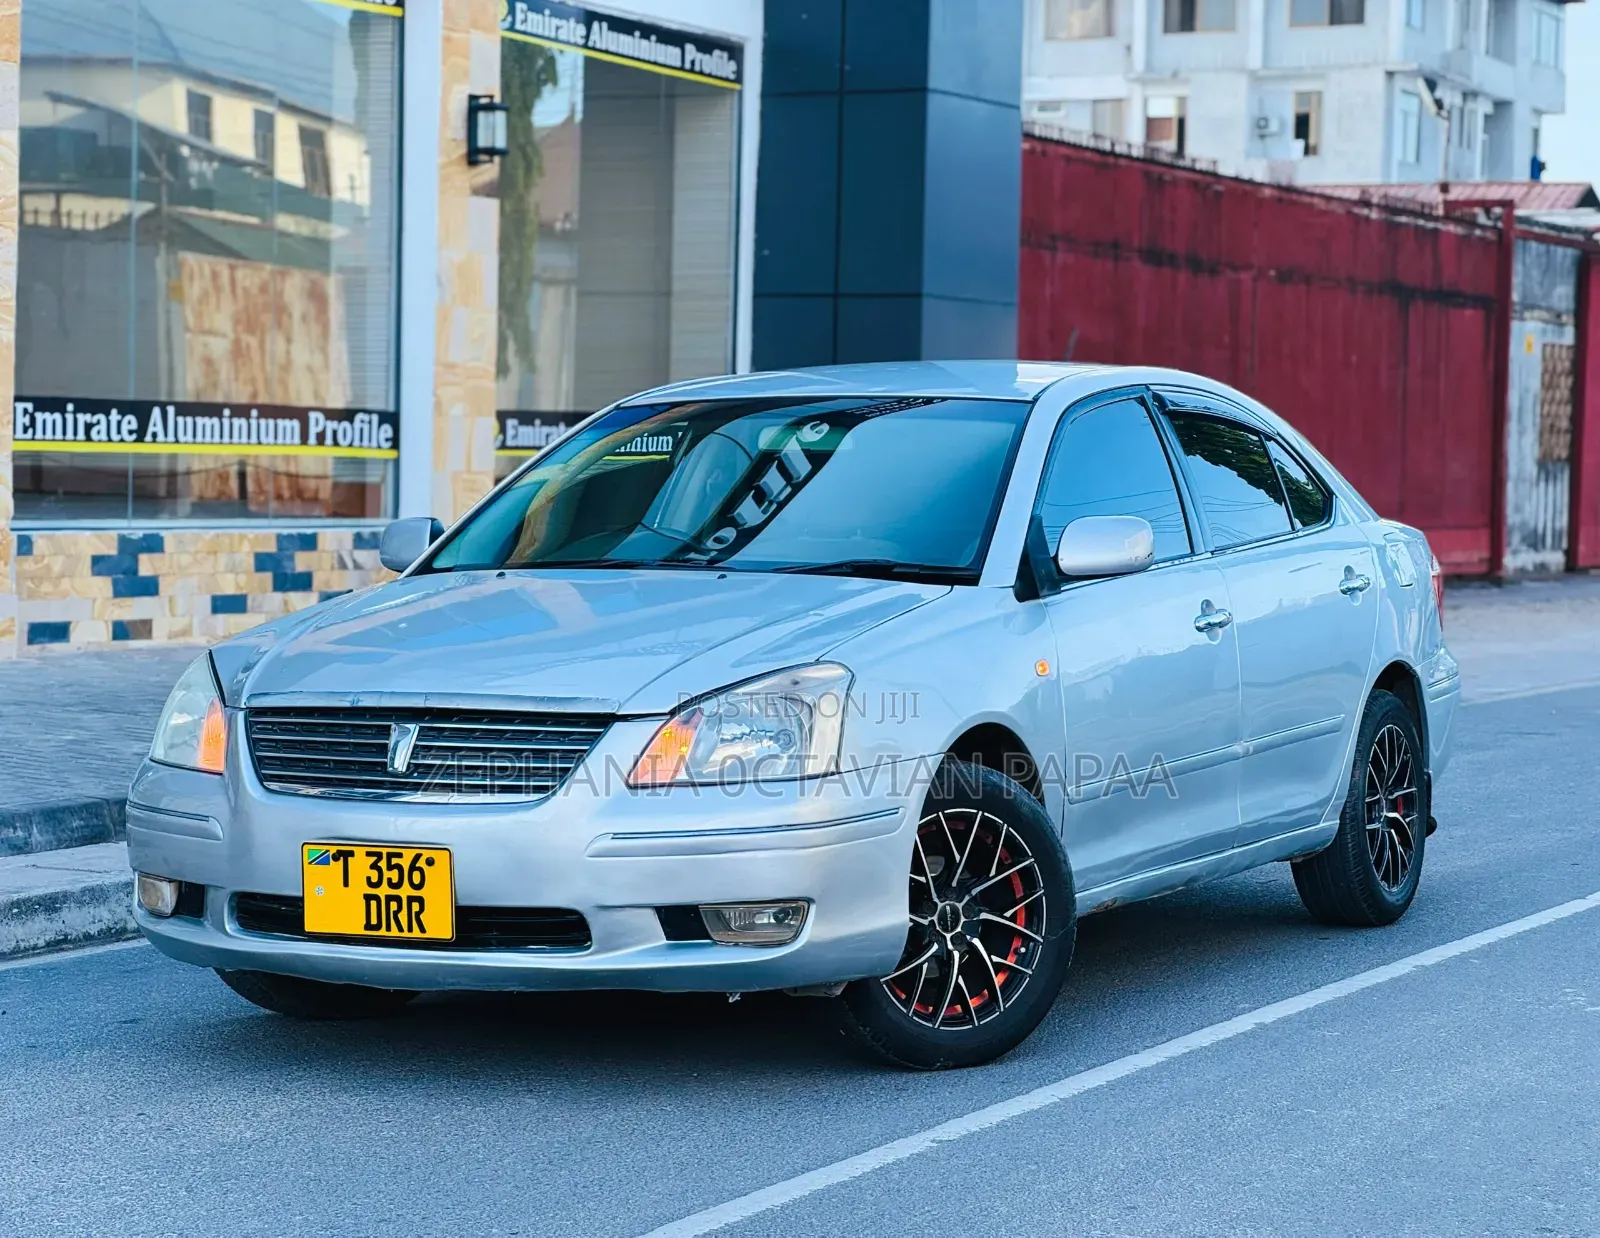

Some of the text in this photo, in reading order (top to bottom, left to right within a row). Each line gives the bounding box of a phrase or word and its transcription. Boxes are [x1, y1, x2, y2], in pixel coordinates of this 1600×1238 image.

[514, 1, 737, 80] Emirate Aluminium Profile
[13, 402, 394, 449] Emirate Aluminium Profile
[505, 417, 574, 448] Emirat
[335, 849, 426, 891] T 356
[363, 893, 427, 934] DRR
